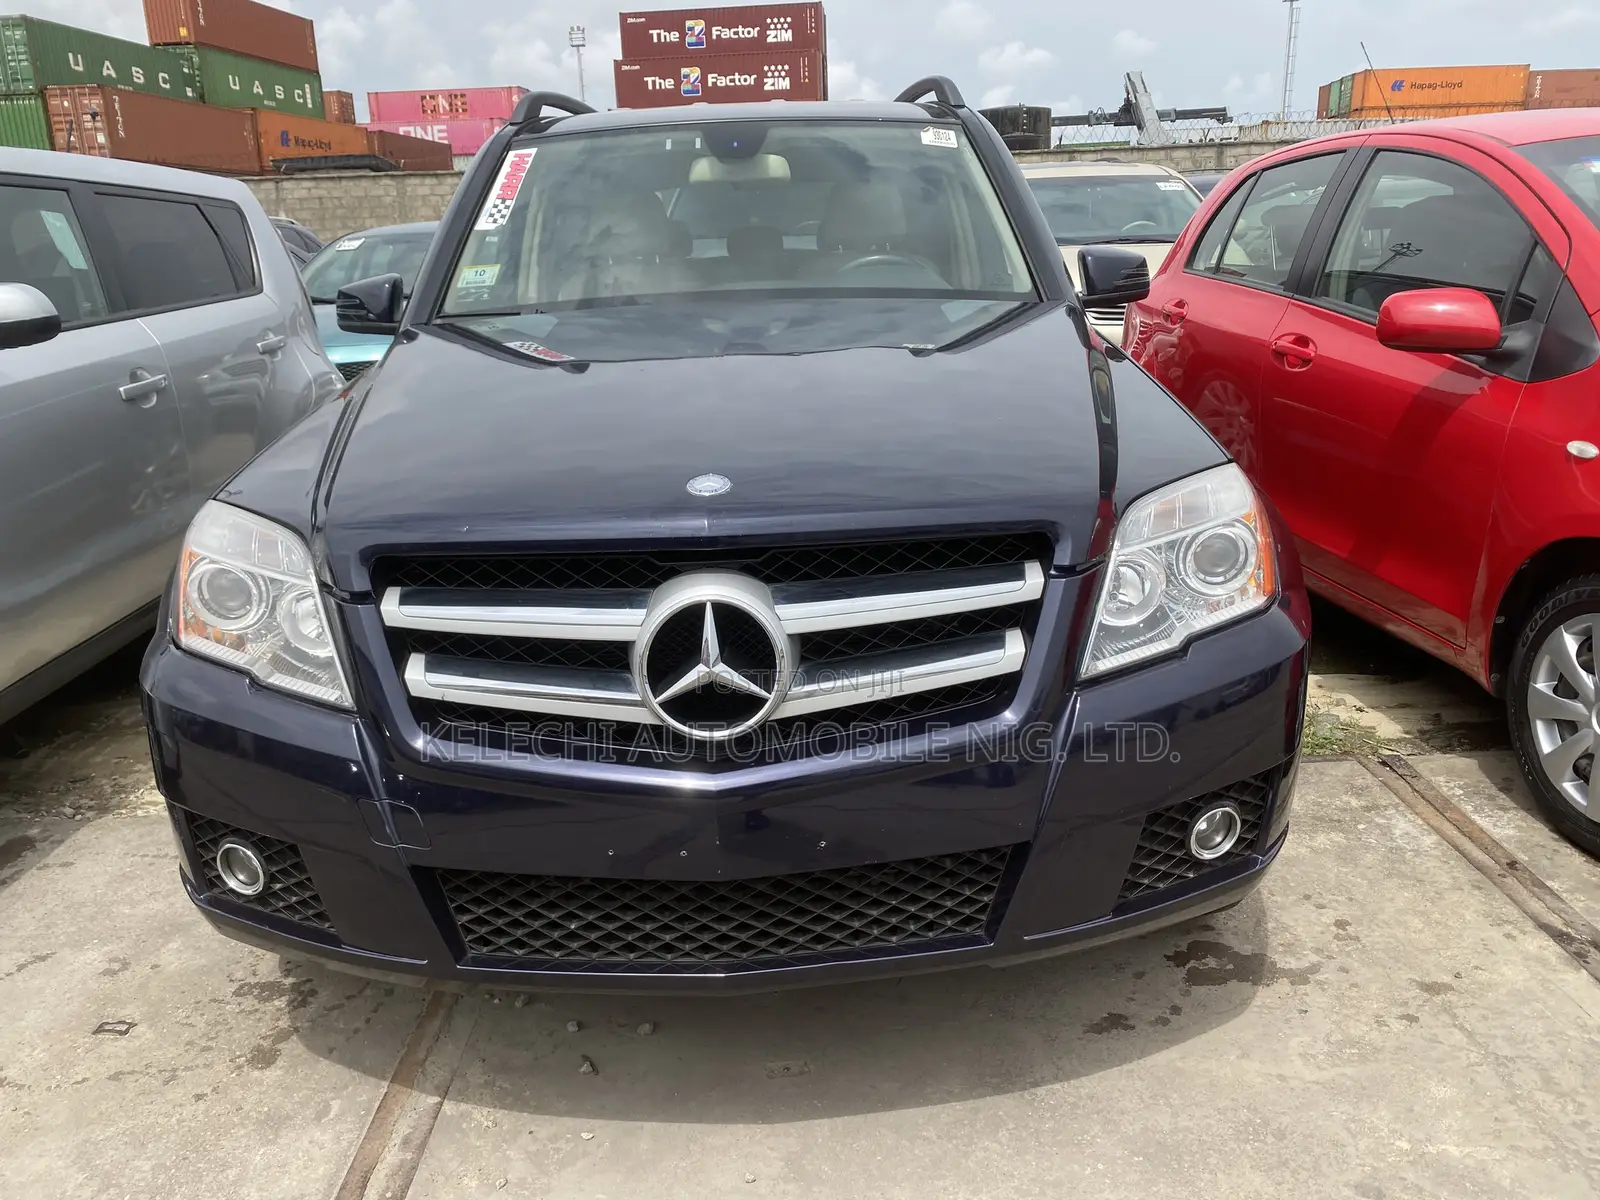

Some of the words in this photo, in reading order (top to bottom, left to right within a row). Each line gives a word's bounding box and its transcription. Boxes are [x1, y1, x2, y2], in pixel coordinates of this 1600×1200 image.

[648, 29, 680, 43] The
[711, 24, 760, 40] Factor
[766, 29, 793, 43] ZIM
[68, 52, 171, 89] UASC
[228, 74, 304, 103] UASC
[643, 76, 675, 90] The
[707, 72, 757, 88] Factor
[763, 77, 790, 91] ZIM
[1410, 80, 1463, 91] Hapag-Lloyd
[420, 92, 468, 114] ONE
[399, 124, 449, 144] ONE
[473, 269, 486, 277] 10
